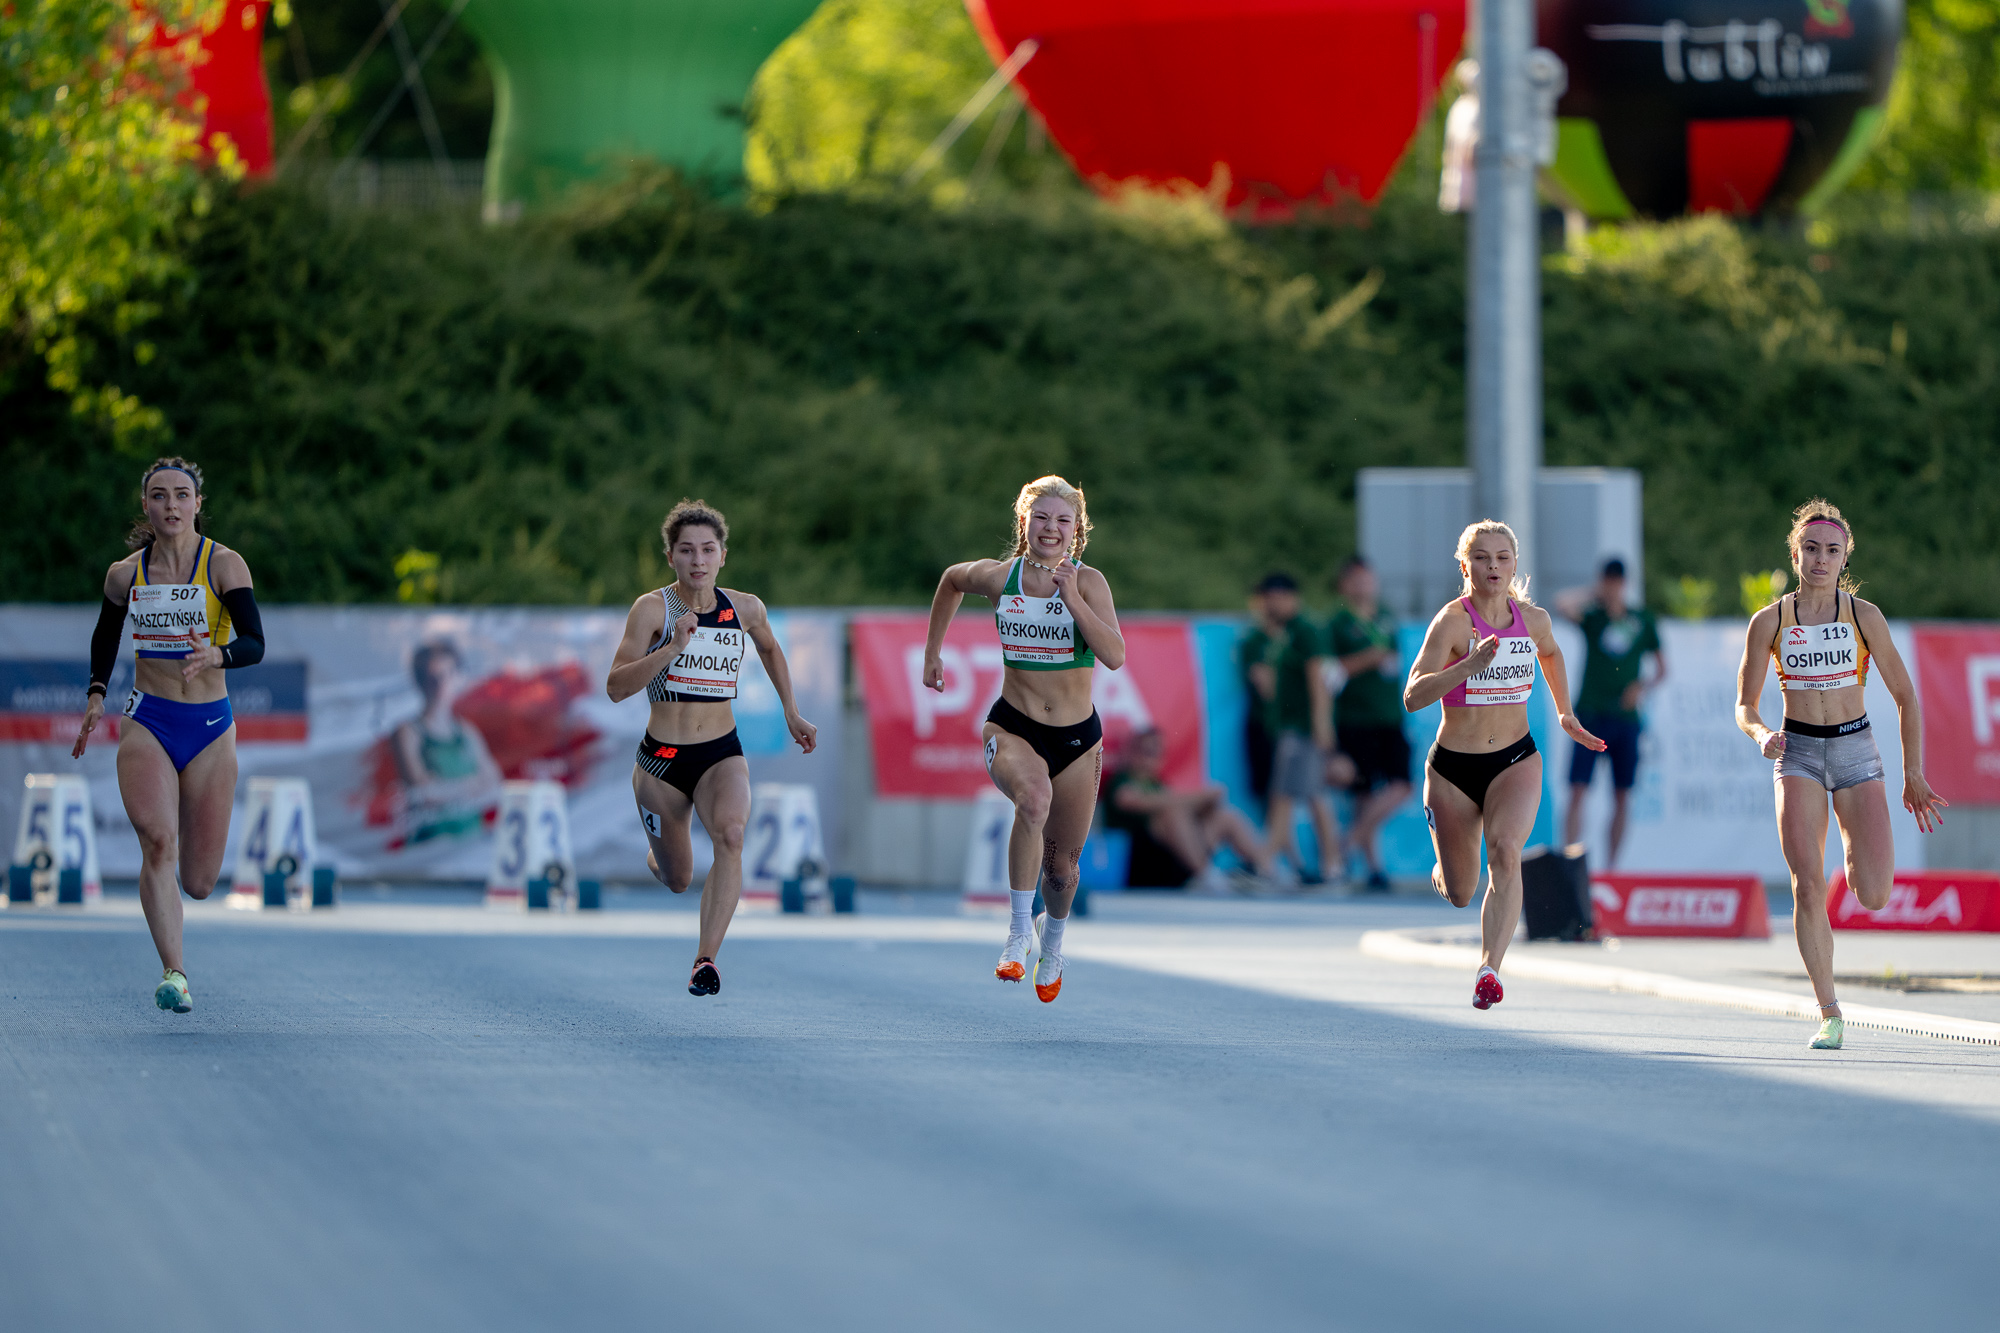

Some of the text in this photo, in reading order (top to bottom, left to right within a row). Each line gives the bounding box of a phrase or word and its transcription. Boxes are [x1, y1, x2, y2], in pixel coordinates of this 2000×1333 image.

[170, 588, 199, 601] 507
[1045, 602, 1063, 616] 98
[714, 632, 738, 646] 461
[1000, 620, 1070, 640] ŁYSKOWKA
[1822, 626, 1849, 640] 119
[1510, 640, 1532, 654] 226
[674, 653, 739, 676] ZIMOLĄG
[1786, 648, 1852, 668] OSIPIUK
[126, 690, 138, 713] 5
[906, 645, 1153, 739] PZA
[1839, 720, 1861, 733] NIKE
[986, 742, 994, 763] 3
[645, 813, 656, 833] 4
